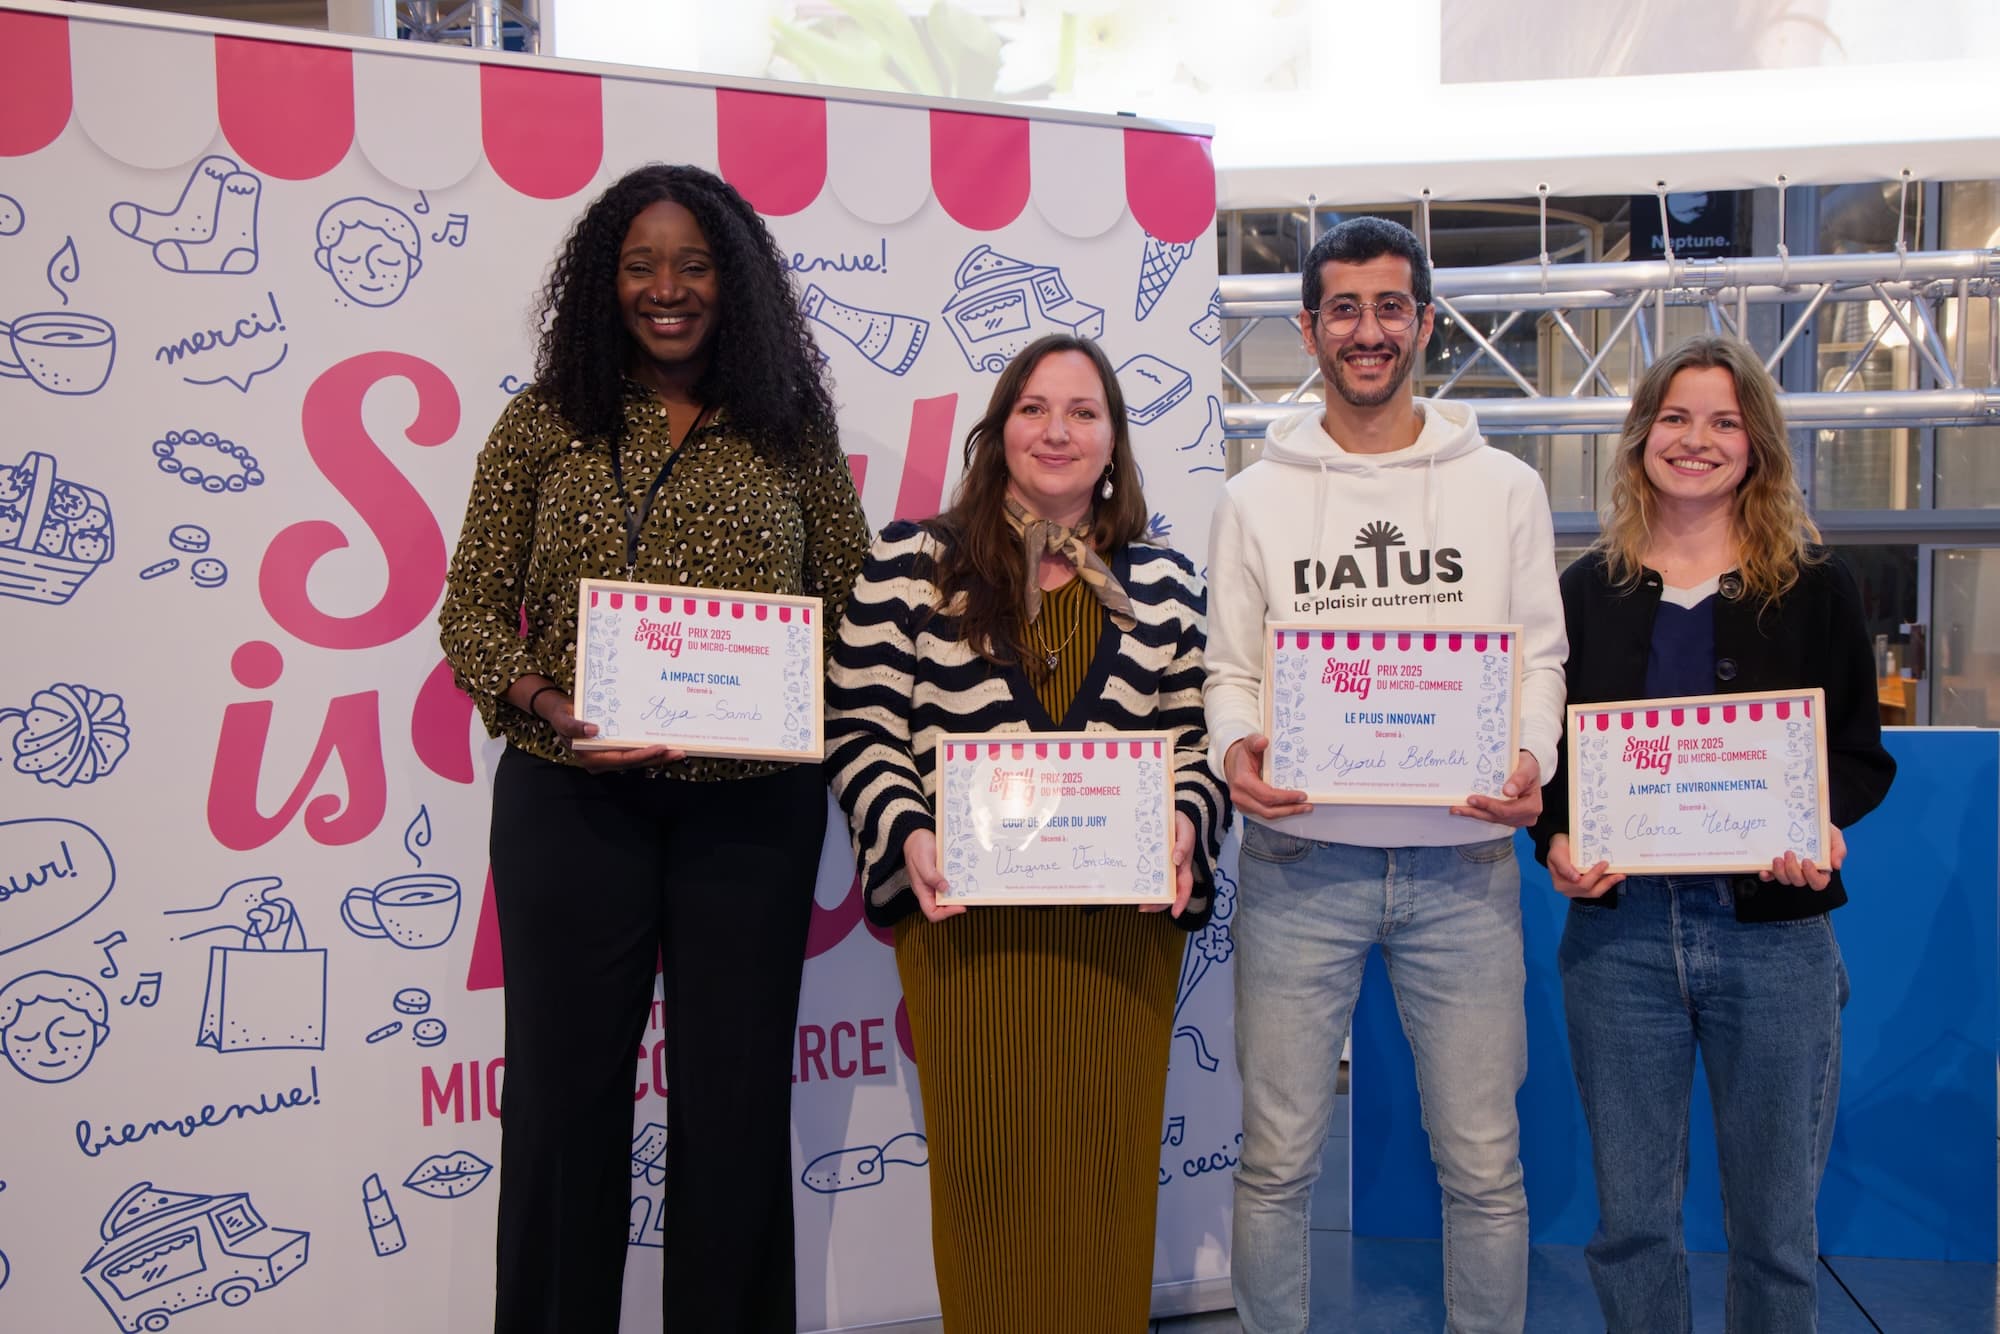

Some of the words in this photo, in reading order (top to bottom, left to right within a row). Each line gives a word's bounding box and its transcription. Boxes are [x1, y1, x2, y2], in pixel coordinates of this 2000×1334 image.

[780, 238, 887, 273] enue!
[155, 291, 286, 365] merci!
[1294, 520, 1463, 595] DATUS
[1294, 601, 1311, 613] Le
[1315, 594, 1368, 615] plaisir
[1371, 590, 1464, 607] autrement
[637, 618, 682, 636] Small
[688, 627, 709, 640] PRIX
[710, 629, 732, 641] 2025
[635, 631, 644, 641] is
[645, 631, 682, 658] Big
[688, 640, 699, 650] DU
[700, 642, 769, 655] MICRO-COMMERCE
[1324, 657, 1370, 676] Small
[1377, 665, 1398, 676] PRIX
[1400, 665, 1422, 677] 2025
[661, 668, 668, 681] À
[670, 671, 705, 683] IMPACT
[708, 674, 741, 686] SOCIAL
[1322, 673, 1331, 684] is
[1332, 671, 1371, 700] Big
[1377, 680, 1387, 690] DU
[1389, 680, 1463, 691] MICRO-COMMERCE
[1345, 712, 1356, 724] LE
[1359, 712, 1384, 724] PLUS
[1386, 713, 1436, 725] INNOVANT
[207, 640, 387, 852] is
[1625, 735, 1670, 752] Small
[1678, 739, 1699, 750] PRIX
[1701, 737, 1724, 749] 2025
[1622, 751, 1632, 762] is
[1633, 748, 1672, 775] Big
[1678, 754, 1688, 764] DU
[1691, 750, 1767, 763] MICRO-COMMERCE
[1040, 773, 1060, 783] PRIX
[1062, 773, 1083, 783] 2025
[1629, 782, 1636, 795] À
[1638, 784, 1671, 795] IMPACT
[1676, 779, 1768, 793] ENVIRONNEMENTAL
[1041, 816, 1069, 827] OEUR
[1071, 816, 1083, 827] DU
[1085, 816, 1107, 827] JURY
[1625, 813, 1680, 840] Clara
[76, 1066, 321, 1157] bienvenue!
